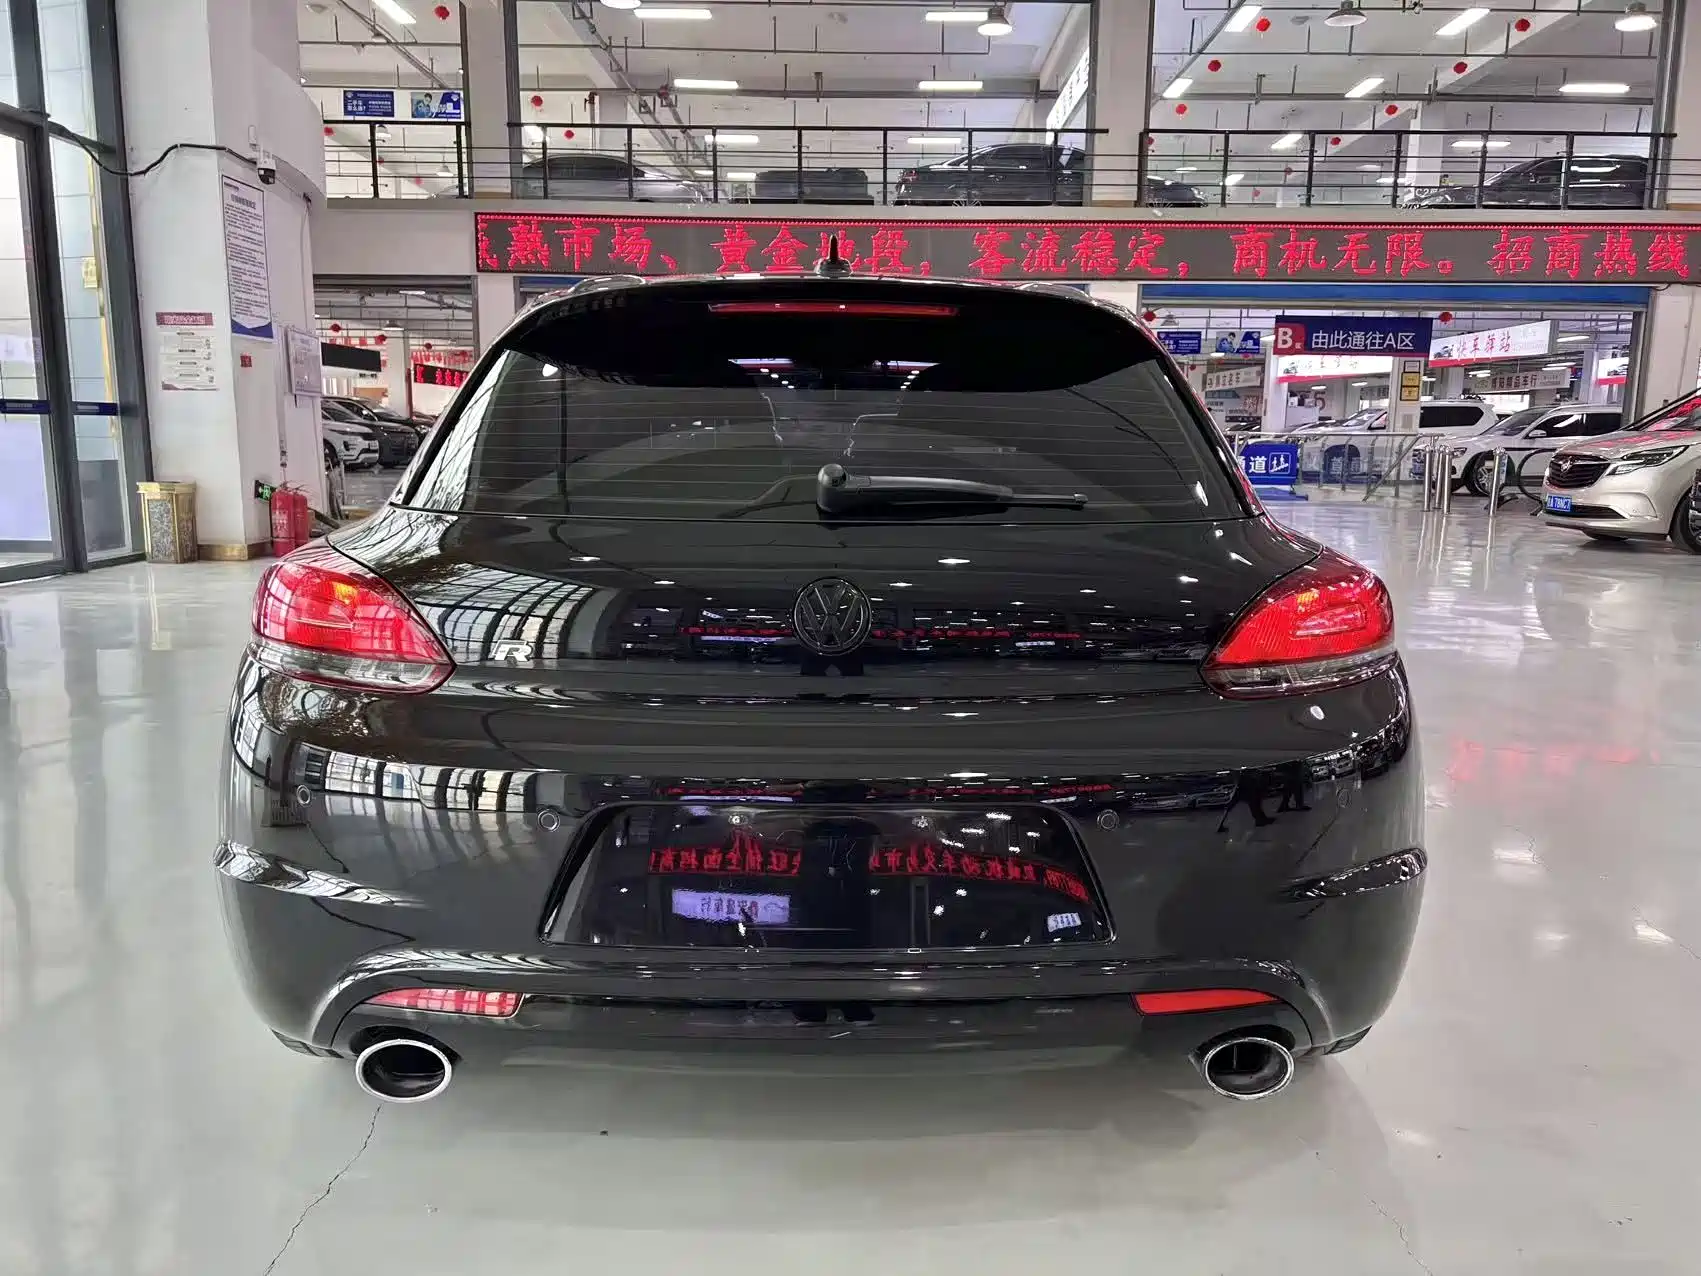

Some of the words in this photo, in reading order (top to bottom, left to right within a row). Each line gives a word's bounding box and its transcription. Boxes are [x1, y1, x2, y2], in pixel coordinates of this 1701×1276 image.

[1311, 330, 1416, 350] 由此通往A区
[492, 639, 533, 662] R
